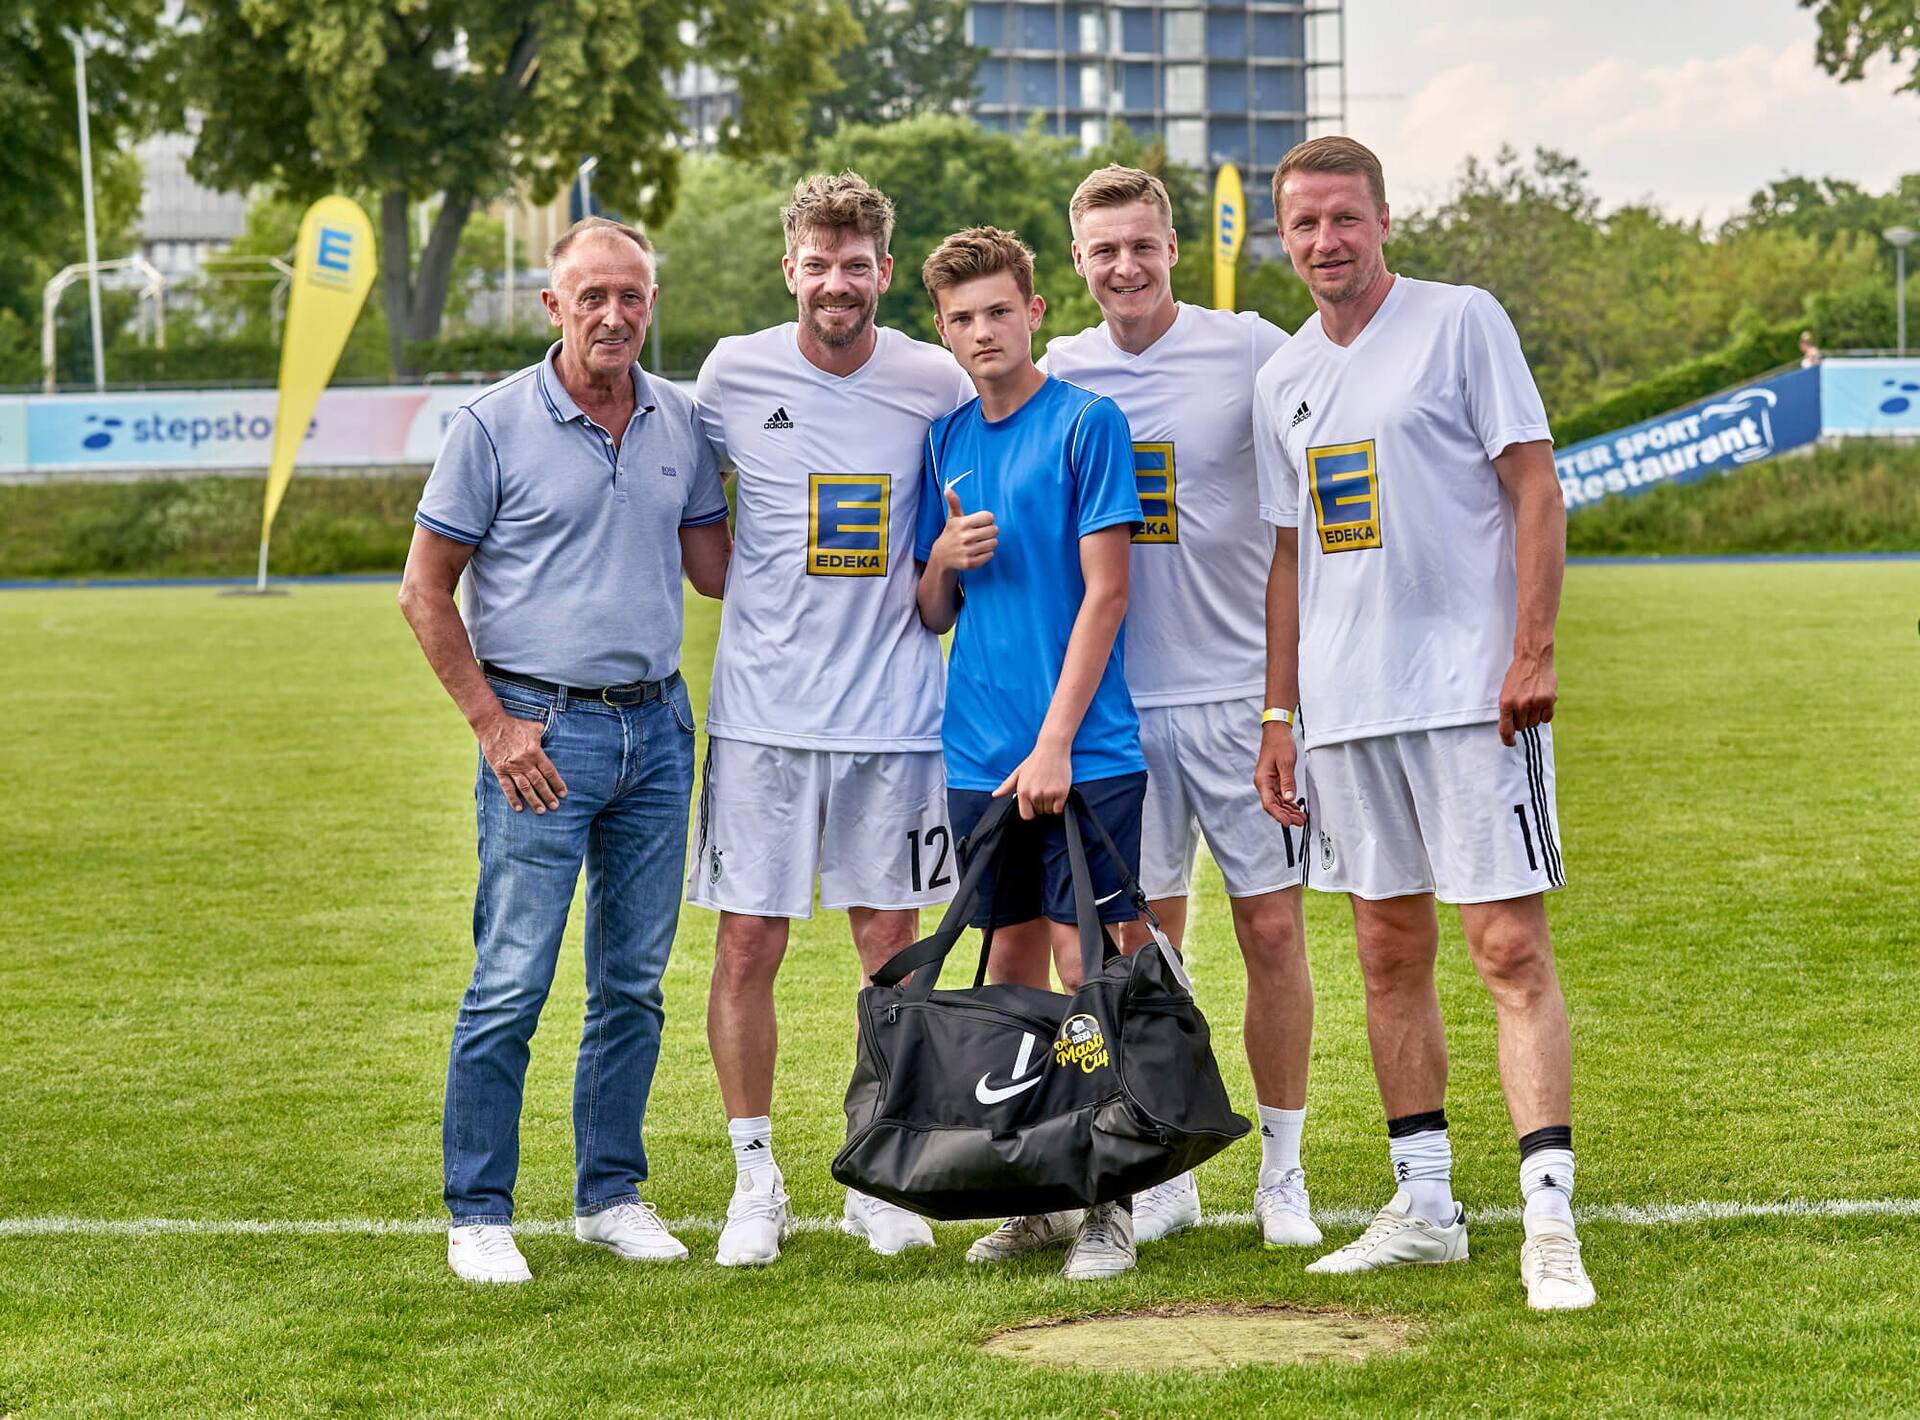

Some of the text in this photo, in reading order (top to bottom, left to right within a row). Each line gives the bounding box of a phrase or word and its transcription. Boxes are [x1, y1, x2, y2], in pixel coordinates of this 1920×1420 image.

[318, 227, 352, 272] E
[133, 412, 318, 449] stepstoe
[763, 421, 794, 430] adidas
[1615, 414, 1702, 460] SPORT
[1560, 417, 1762, 508] Restaurant
[1315, 451, 1372, 526] E
[817, 483, 882, 550] E
[1324, 526, 1375, 544] EDEKA
[815, 554, 880, 568] EDEKA
[907, 825, 952, 892] 12
[1513, 804, 1539, 871] 1
